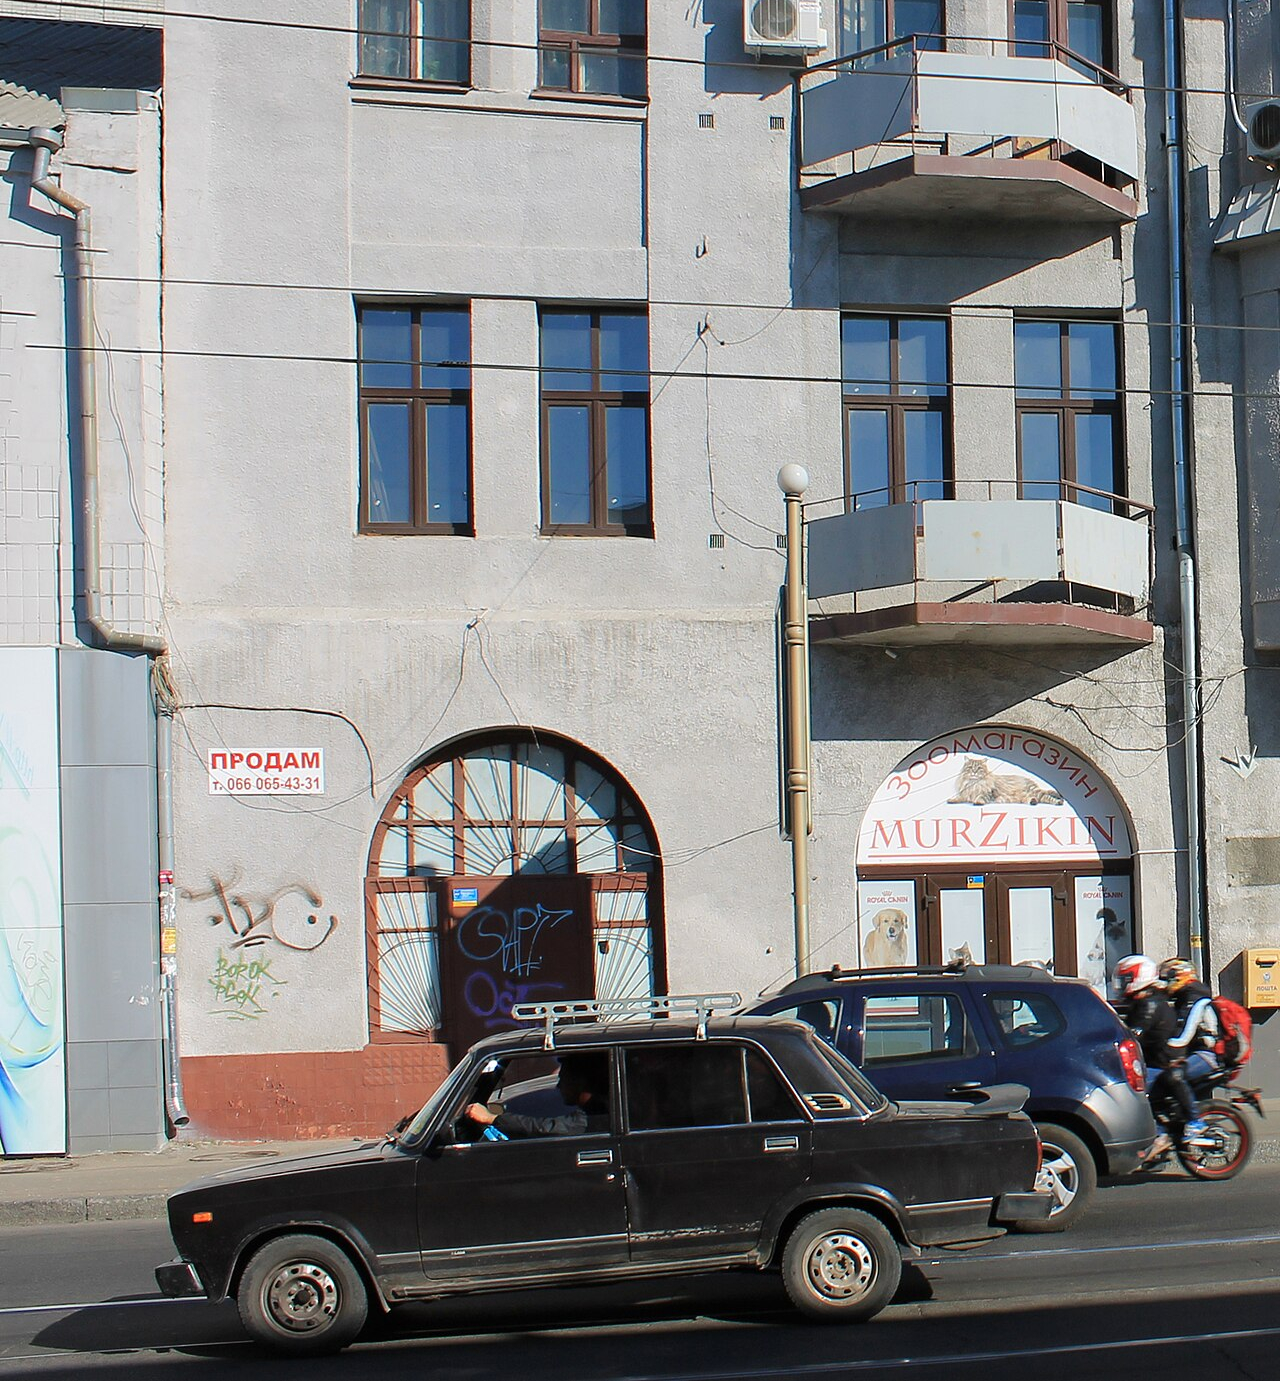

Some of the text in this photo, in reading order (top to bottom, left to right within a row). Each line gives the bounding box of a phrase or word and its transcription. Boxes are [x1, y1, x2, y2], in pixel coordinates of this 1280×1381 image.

[211, 752, 320, 773] ПРОДАМ
[213, 776, 320, 791] т. 066 065-43-31
